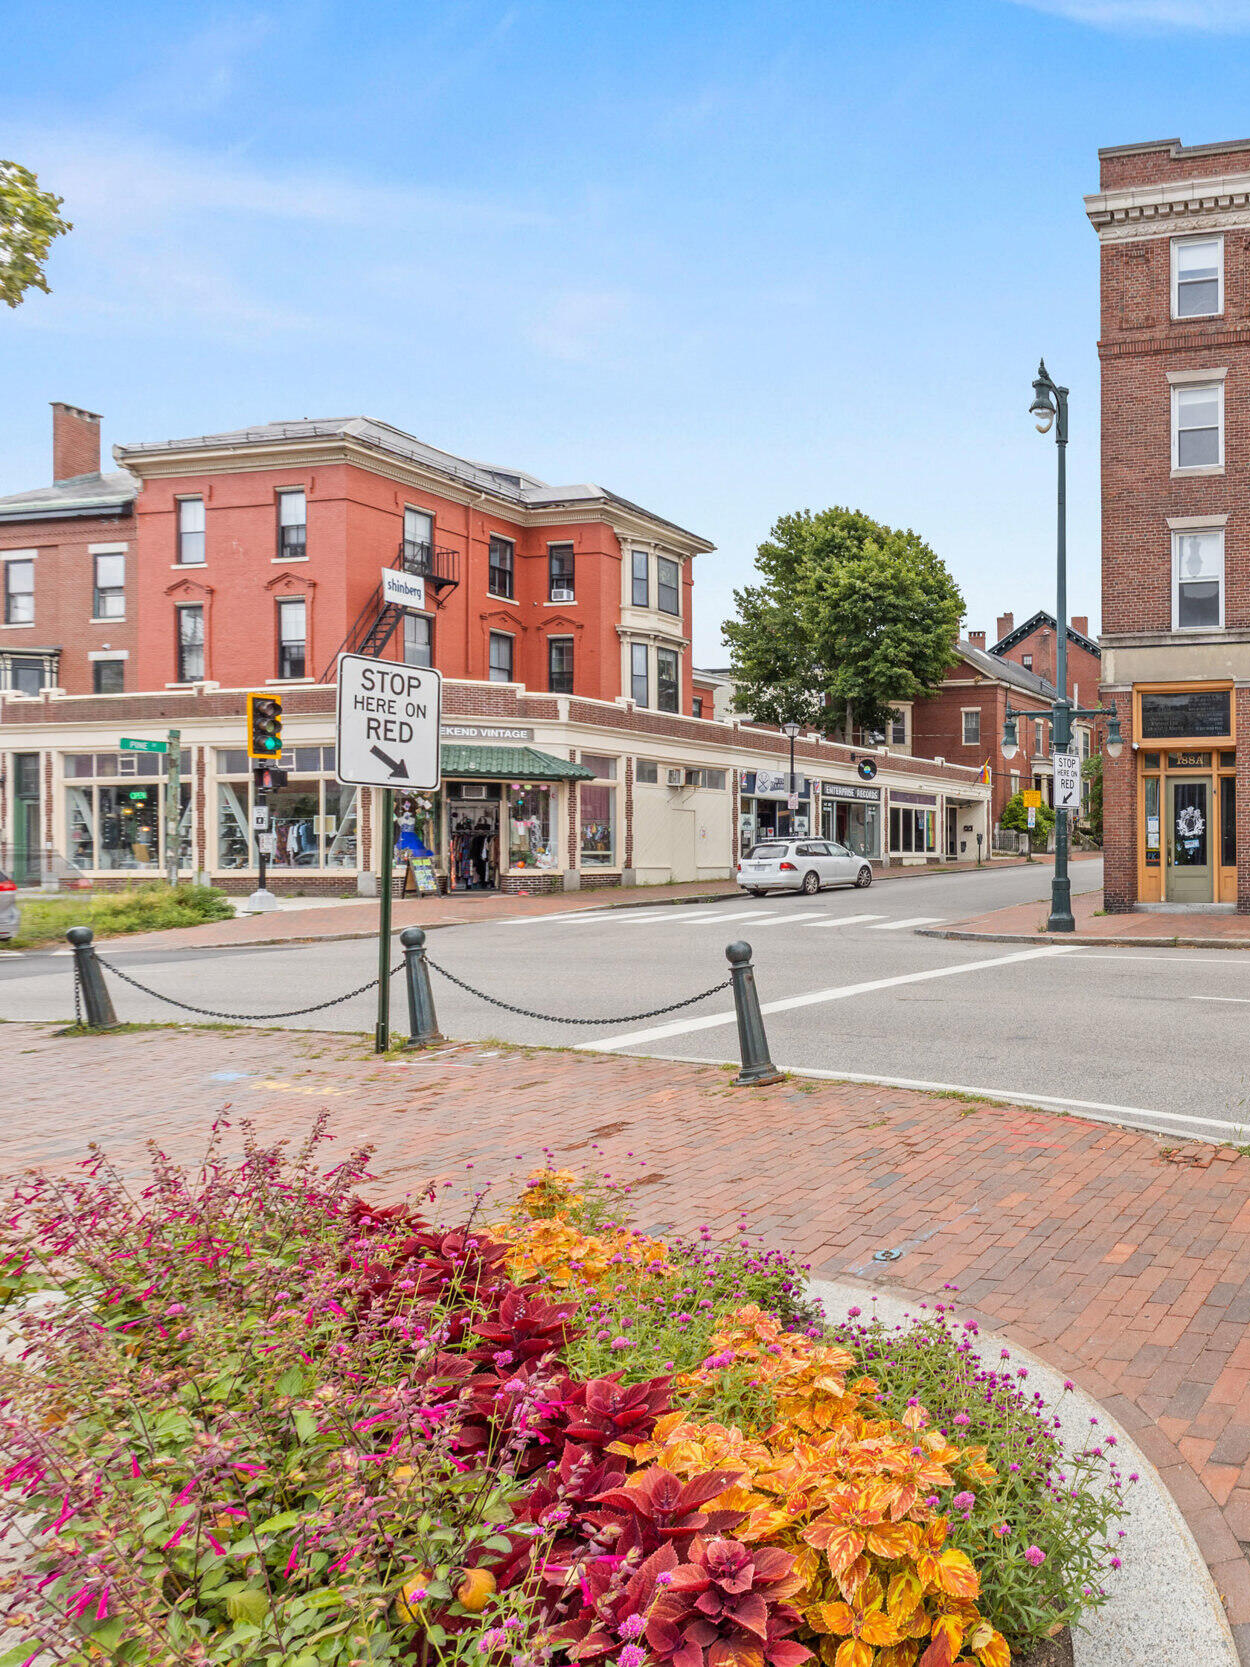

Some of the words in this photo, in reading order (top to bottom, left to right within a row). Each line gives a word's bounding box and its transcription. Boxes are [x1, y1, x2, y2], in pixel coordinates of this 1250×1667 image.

[387, 578, 422, 601] shinberg
[361, 668, 421, 697] STOP
[354, 694, 397, 715] HERE
[405, 702, 426, 719] ON
[366, 717, 413, 743] RED
[440, 726, 478, 737] EKEND
[480, 728, 528, 739] VINTAGE
[1058, 758, 1076, 768] STOP
[1176, 755, 1204, 765] 188A
[1060, 778, 1074, 789] RED
[826, 785, 855, 798] ENTERPRISE
[856, 788, 878, 800] RECORDS
